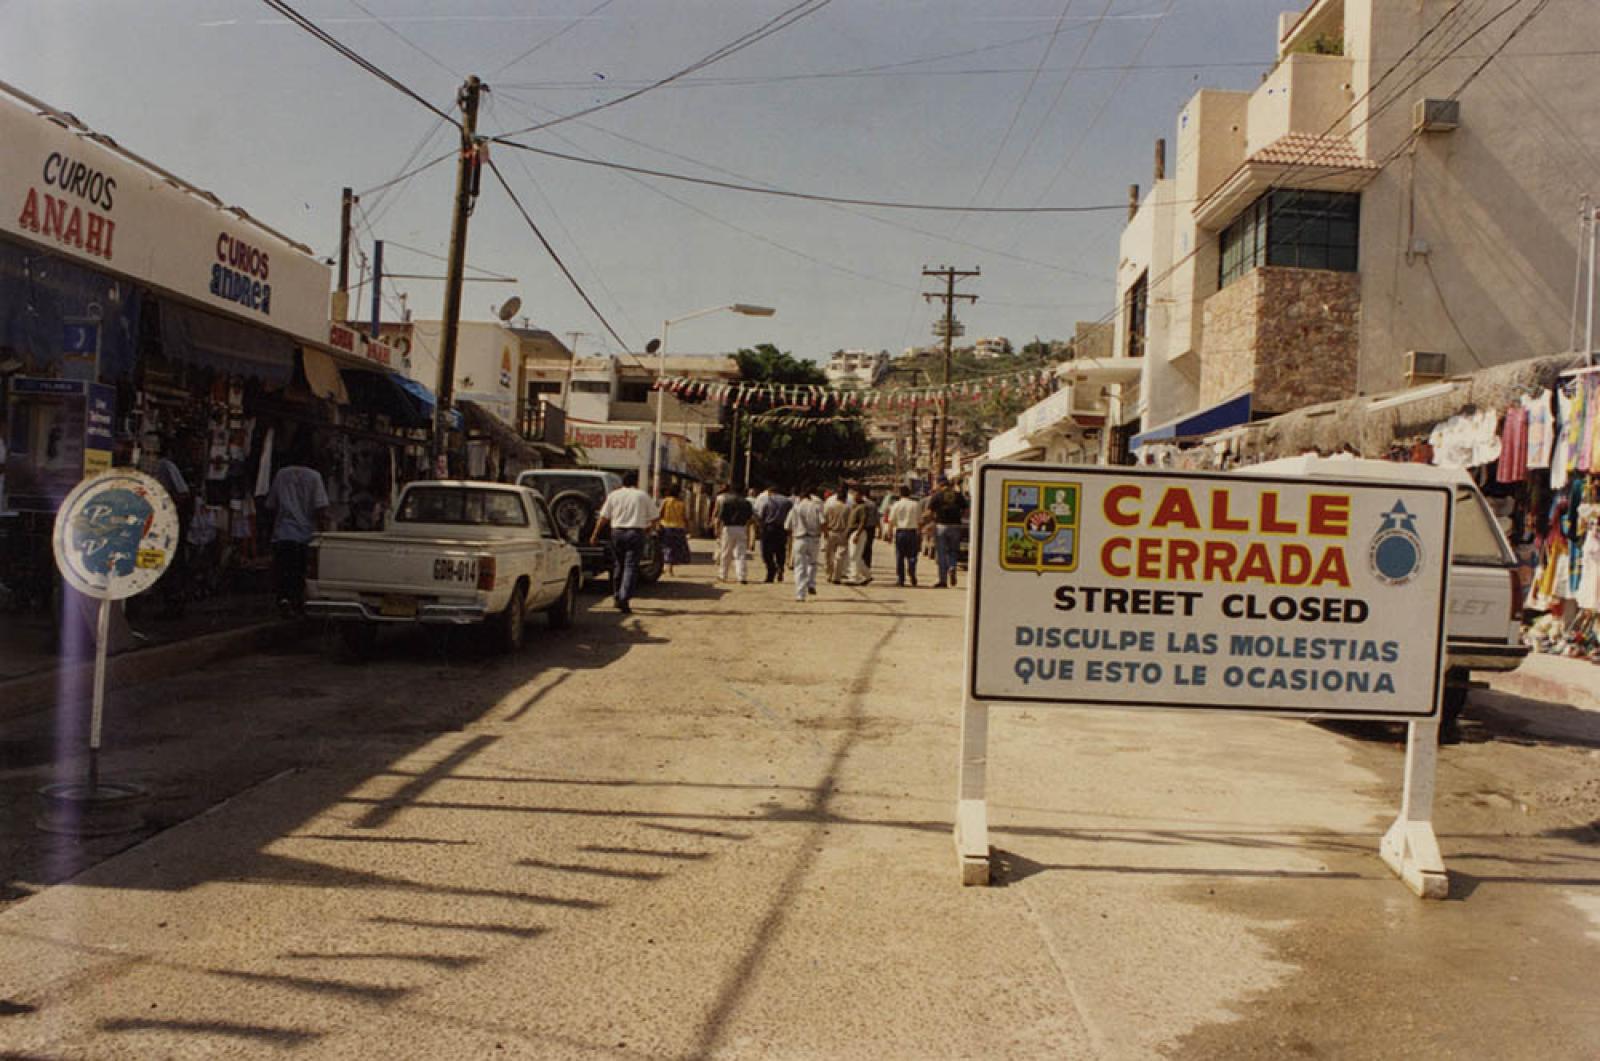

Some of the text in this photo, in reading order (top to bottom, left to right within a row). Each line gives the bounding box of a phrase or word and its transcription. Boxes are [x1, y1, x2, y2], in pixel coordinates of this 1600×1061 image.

[44, 152, 116, 211] CURIOS
[19, 187, 115, 261] ANAHI
[216, 231, 270, 280] CURIOS
[1102, 484, 1352, 537] CALLE
[1099, 536, 1352, 588] CERRADA
[1053, 584, 1370, 624] STREET CLOSED
[1014, 626, 1400, 664] DISCULPE LAS MOLESTIAS
[1014, 655, 1396, 694] QUE ESTO LE OCASIONA
